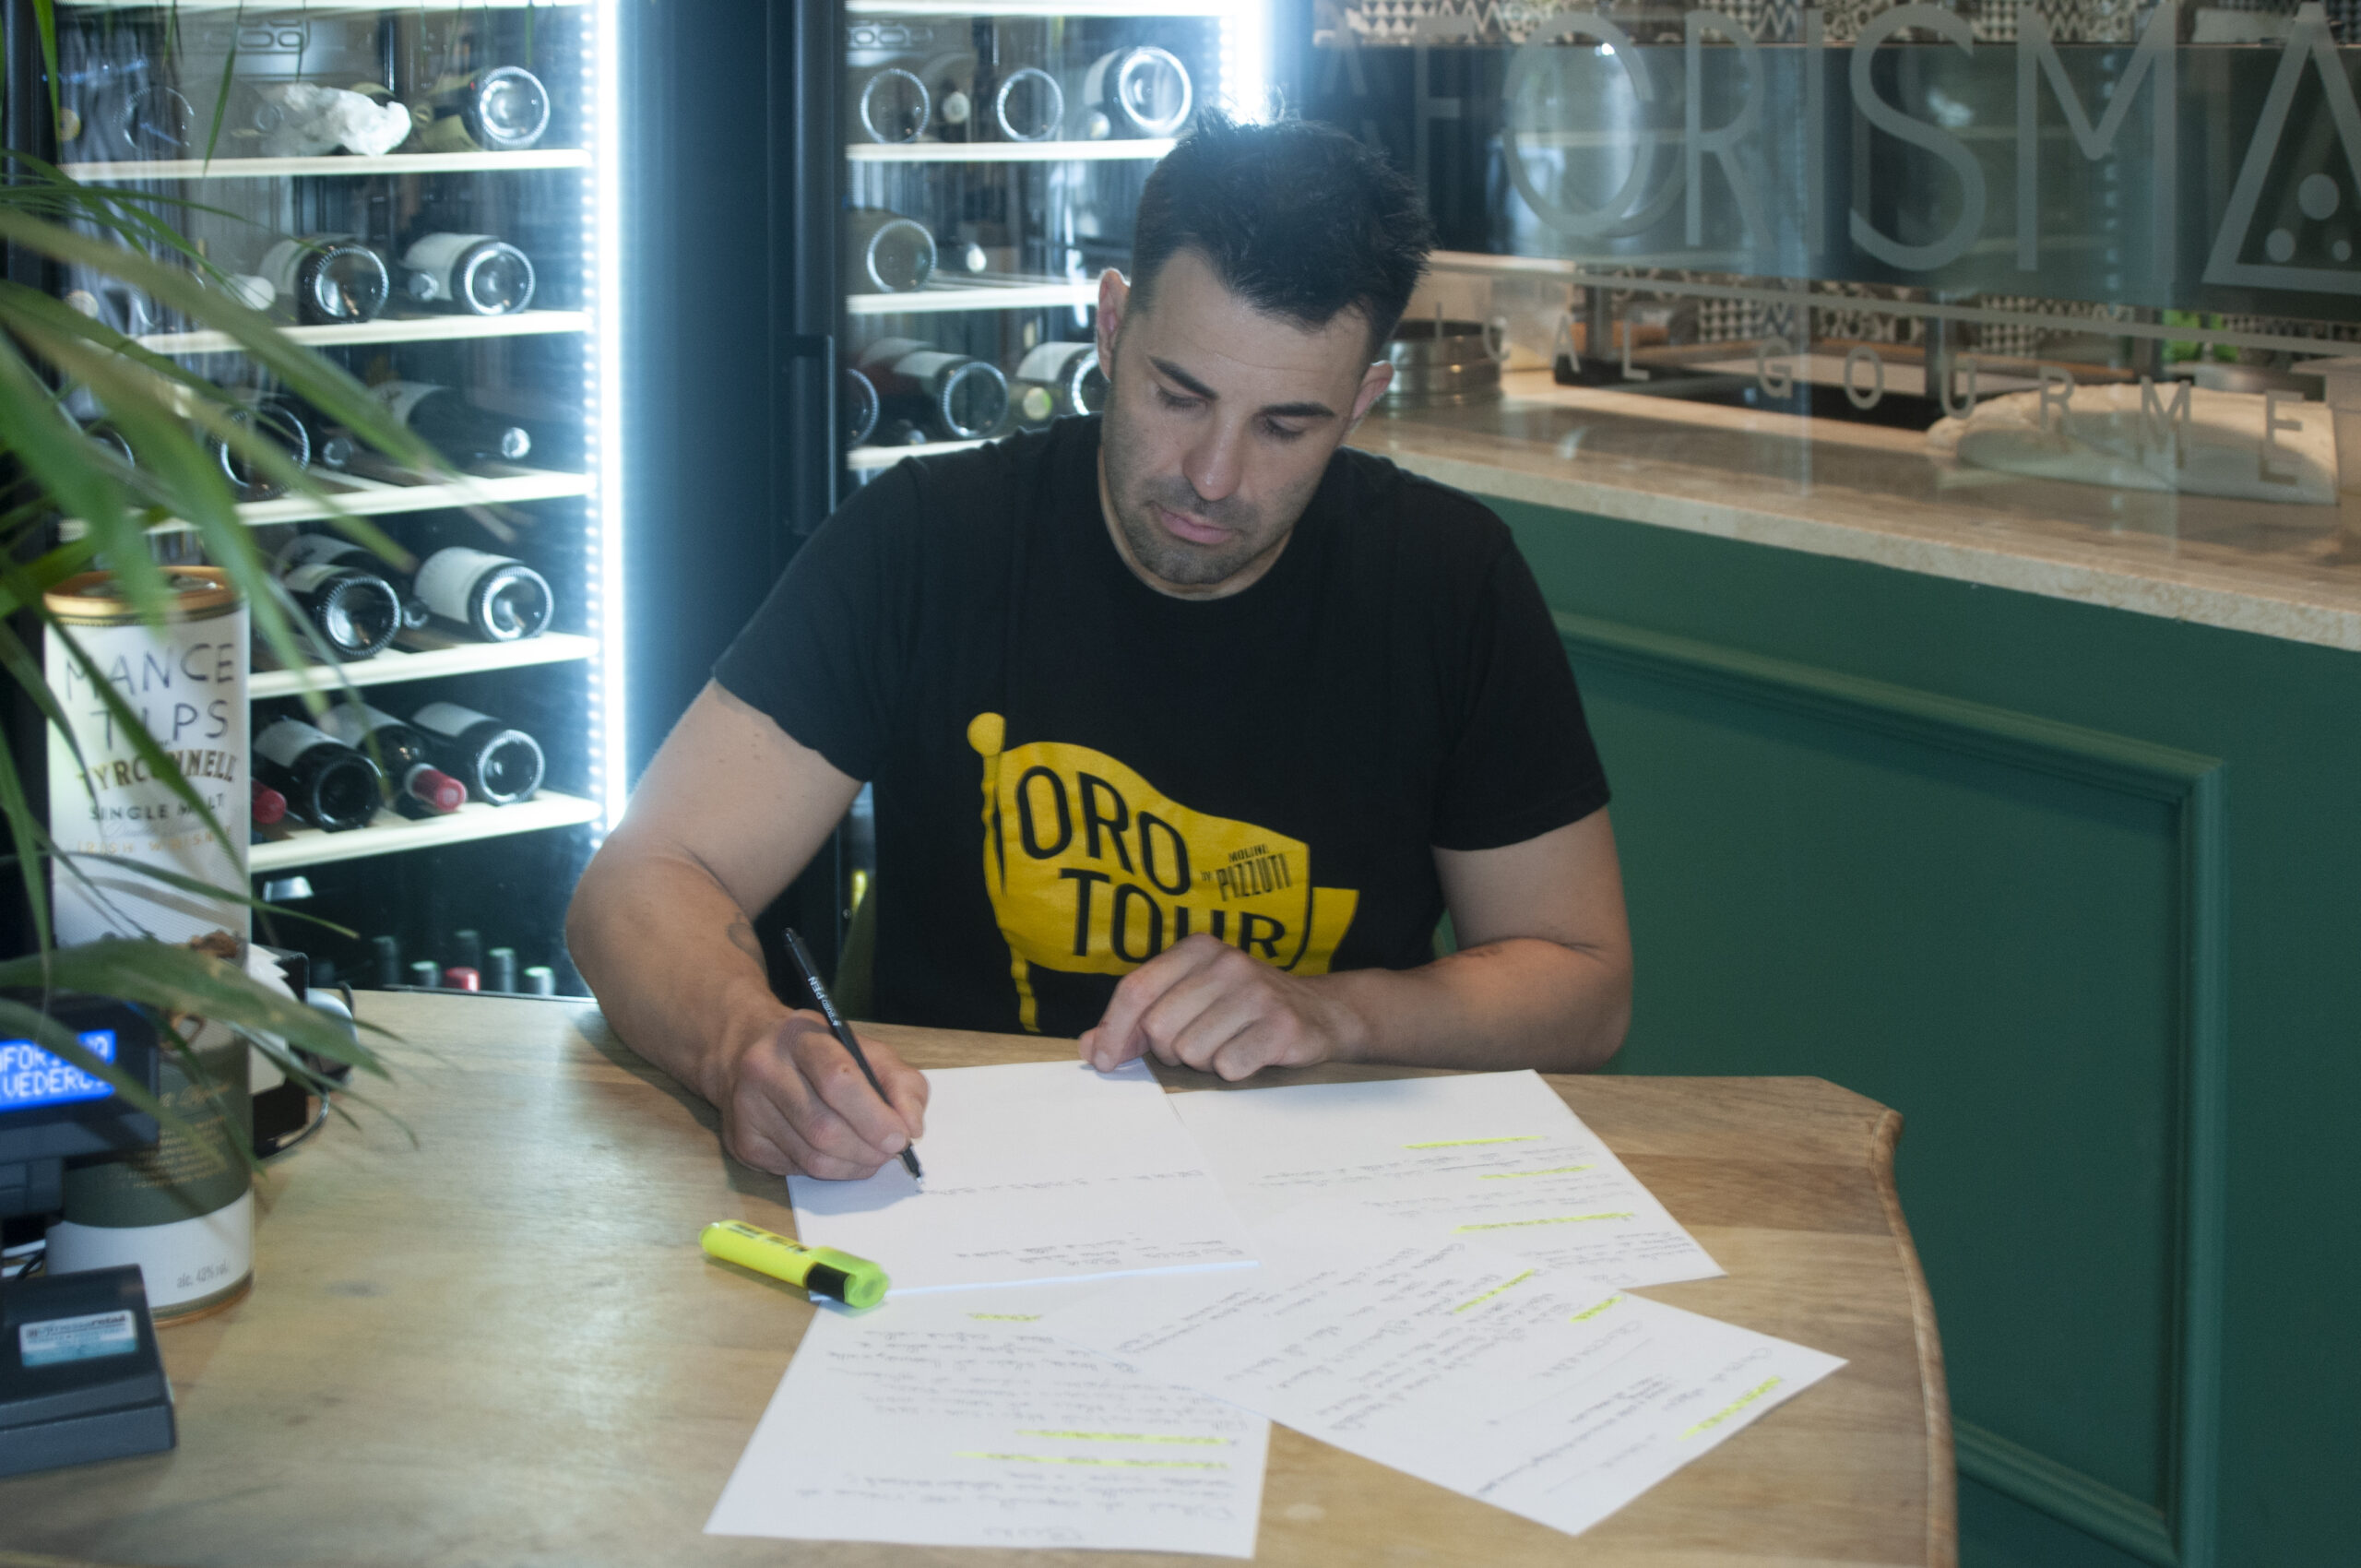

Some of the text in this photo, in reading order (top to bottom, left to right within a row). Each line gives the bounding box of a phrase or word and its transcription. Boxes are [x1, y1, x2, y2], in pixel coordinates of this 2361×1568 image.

[1433, 301, 1651, 382] ICAL
[66, 642, 234, 701] MANCE
[89, 791, 225, 821] SINGLE MLT
[1016, 765, 1192, 897] ORO
[1216, 853, 1292, 902] PIZZUTI
[808, 976, 825, 1001] PEN
